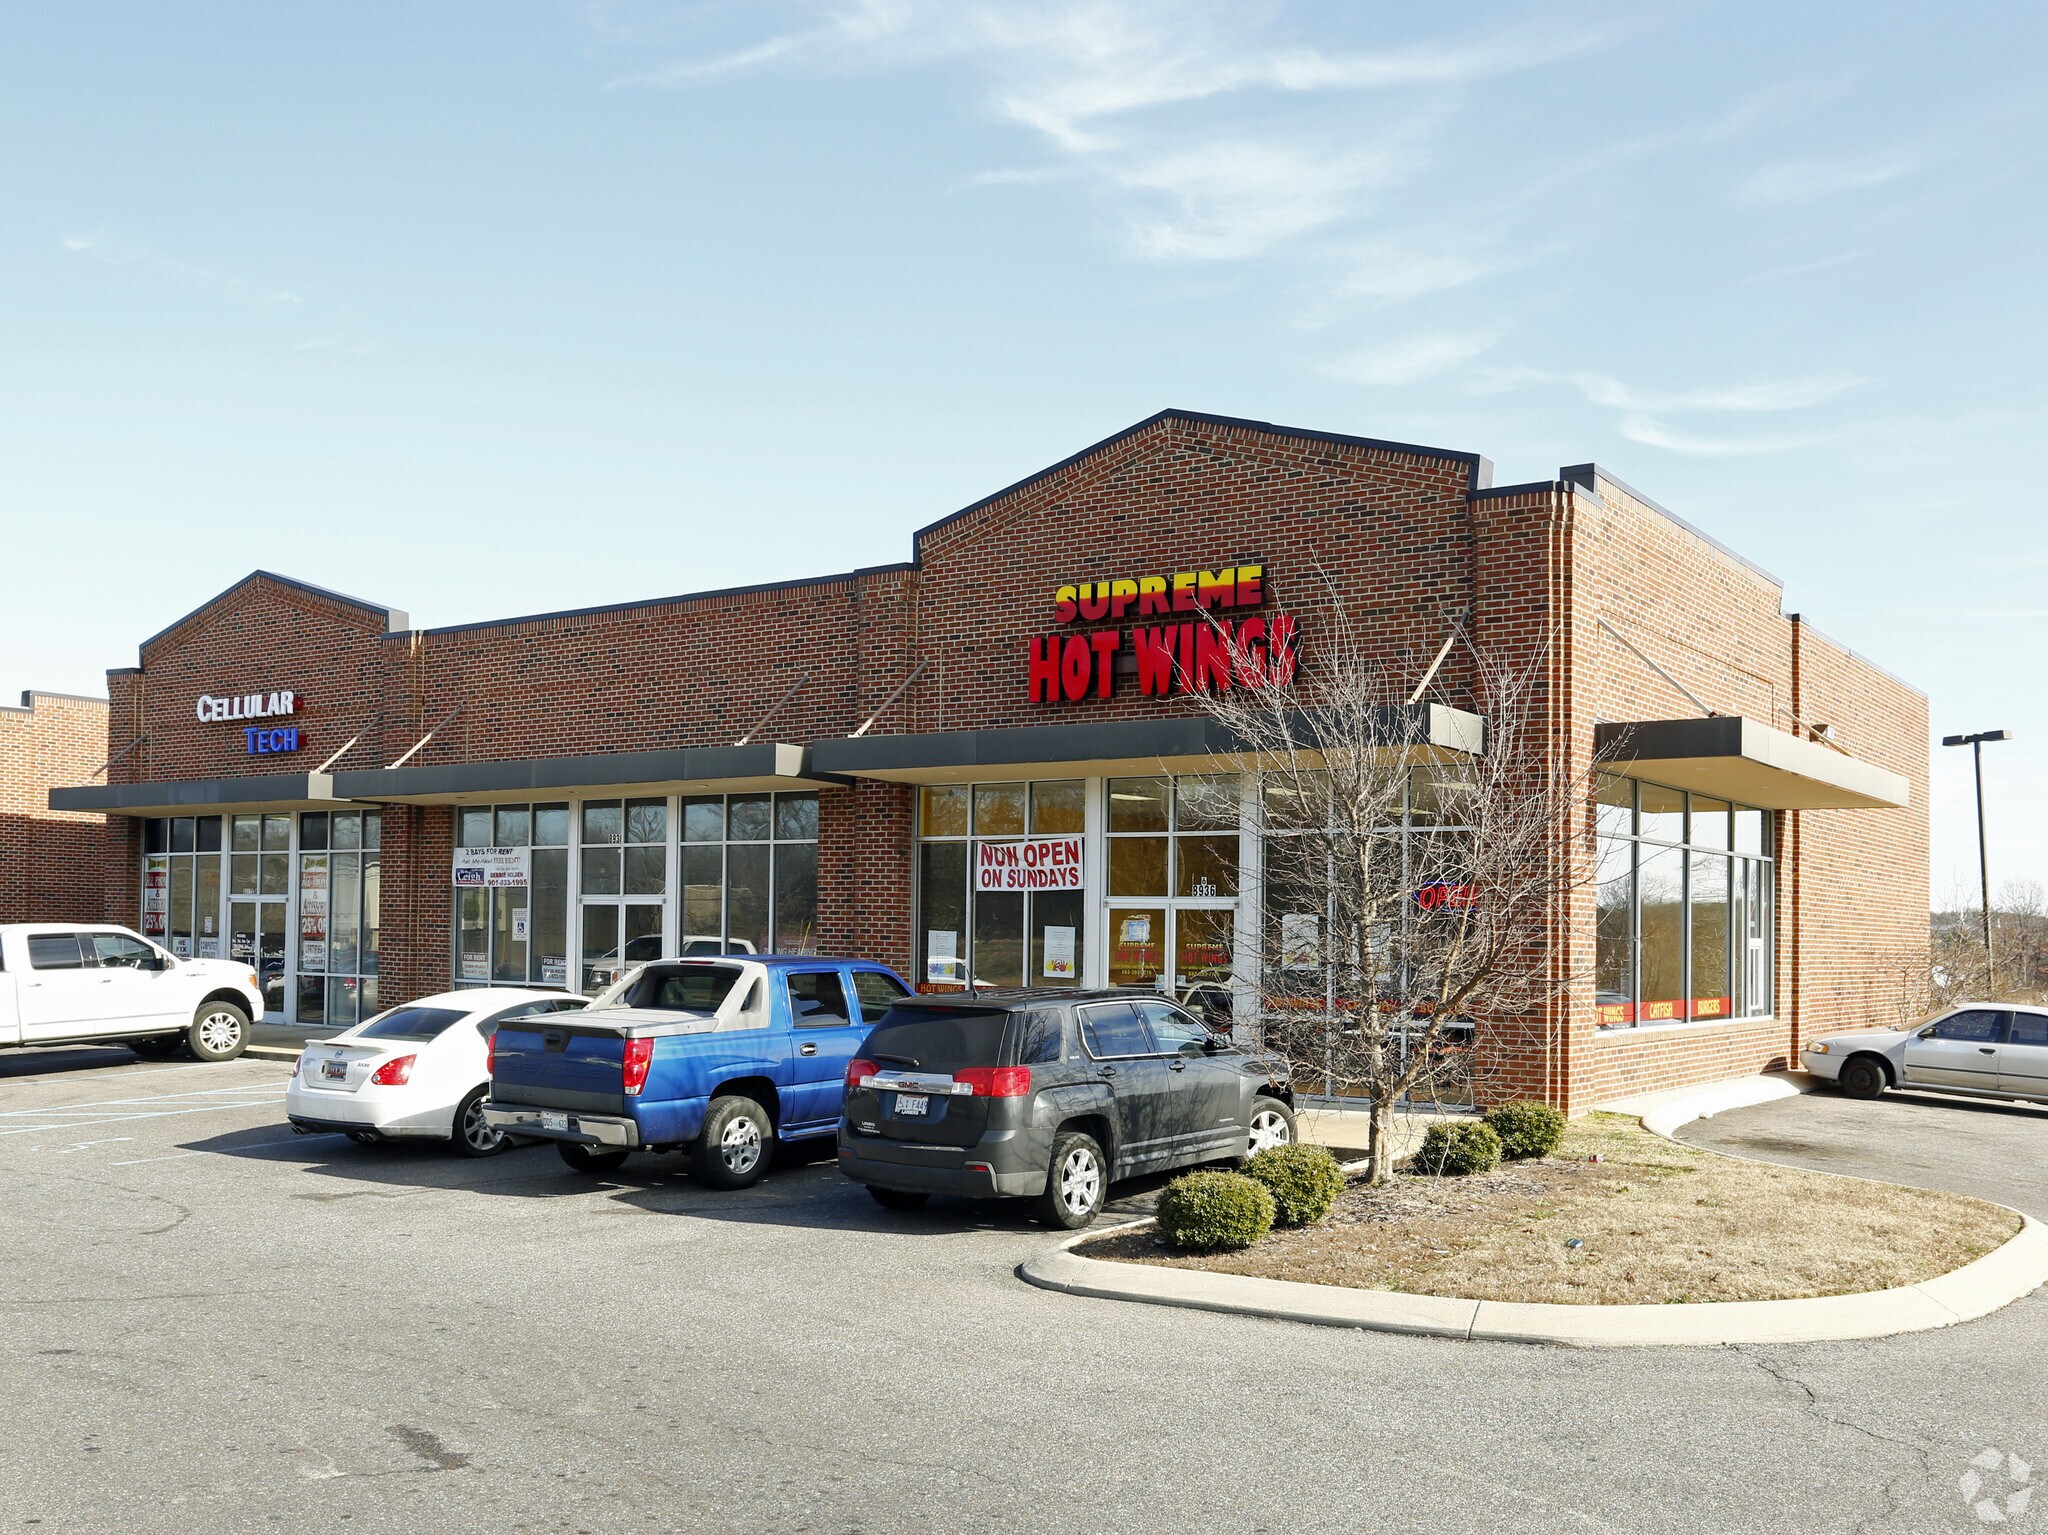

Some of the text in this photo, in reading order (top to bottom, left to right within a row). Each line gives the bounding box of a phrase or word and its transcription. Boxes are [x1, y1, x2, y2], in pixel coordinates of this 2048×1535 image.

[1054, 565, 1264, 623] SUPREME
[1029, 614, 1298, 703] HOT WINGS
[197, 691, 294, 723] CELLULAR
[243, 727, 299, 755] TECH
[471, 848, 486, 856] BAYS
[980, 840, 1080, 868] NOW OPEN
[981, 866, 1079, 888] ON SUNDAYS
[1193, 885, 1216, 897] 8936
[920, 985, 936, 993] HOT
[1604, 1006, 1625, 1023] WINGS
[1649, 1002, 1673, 1019] CATFISH
[1697, 999, 1720, 1015] BURGERS
